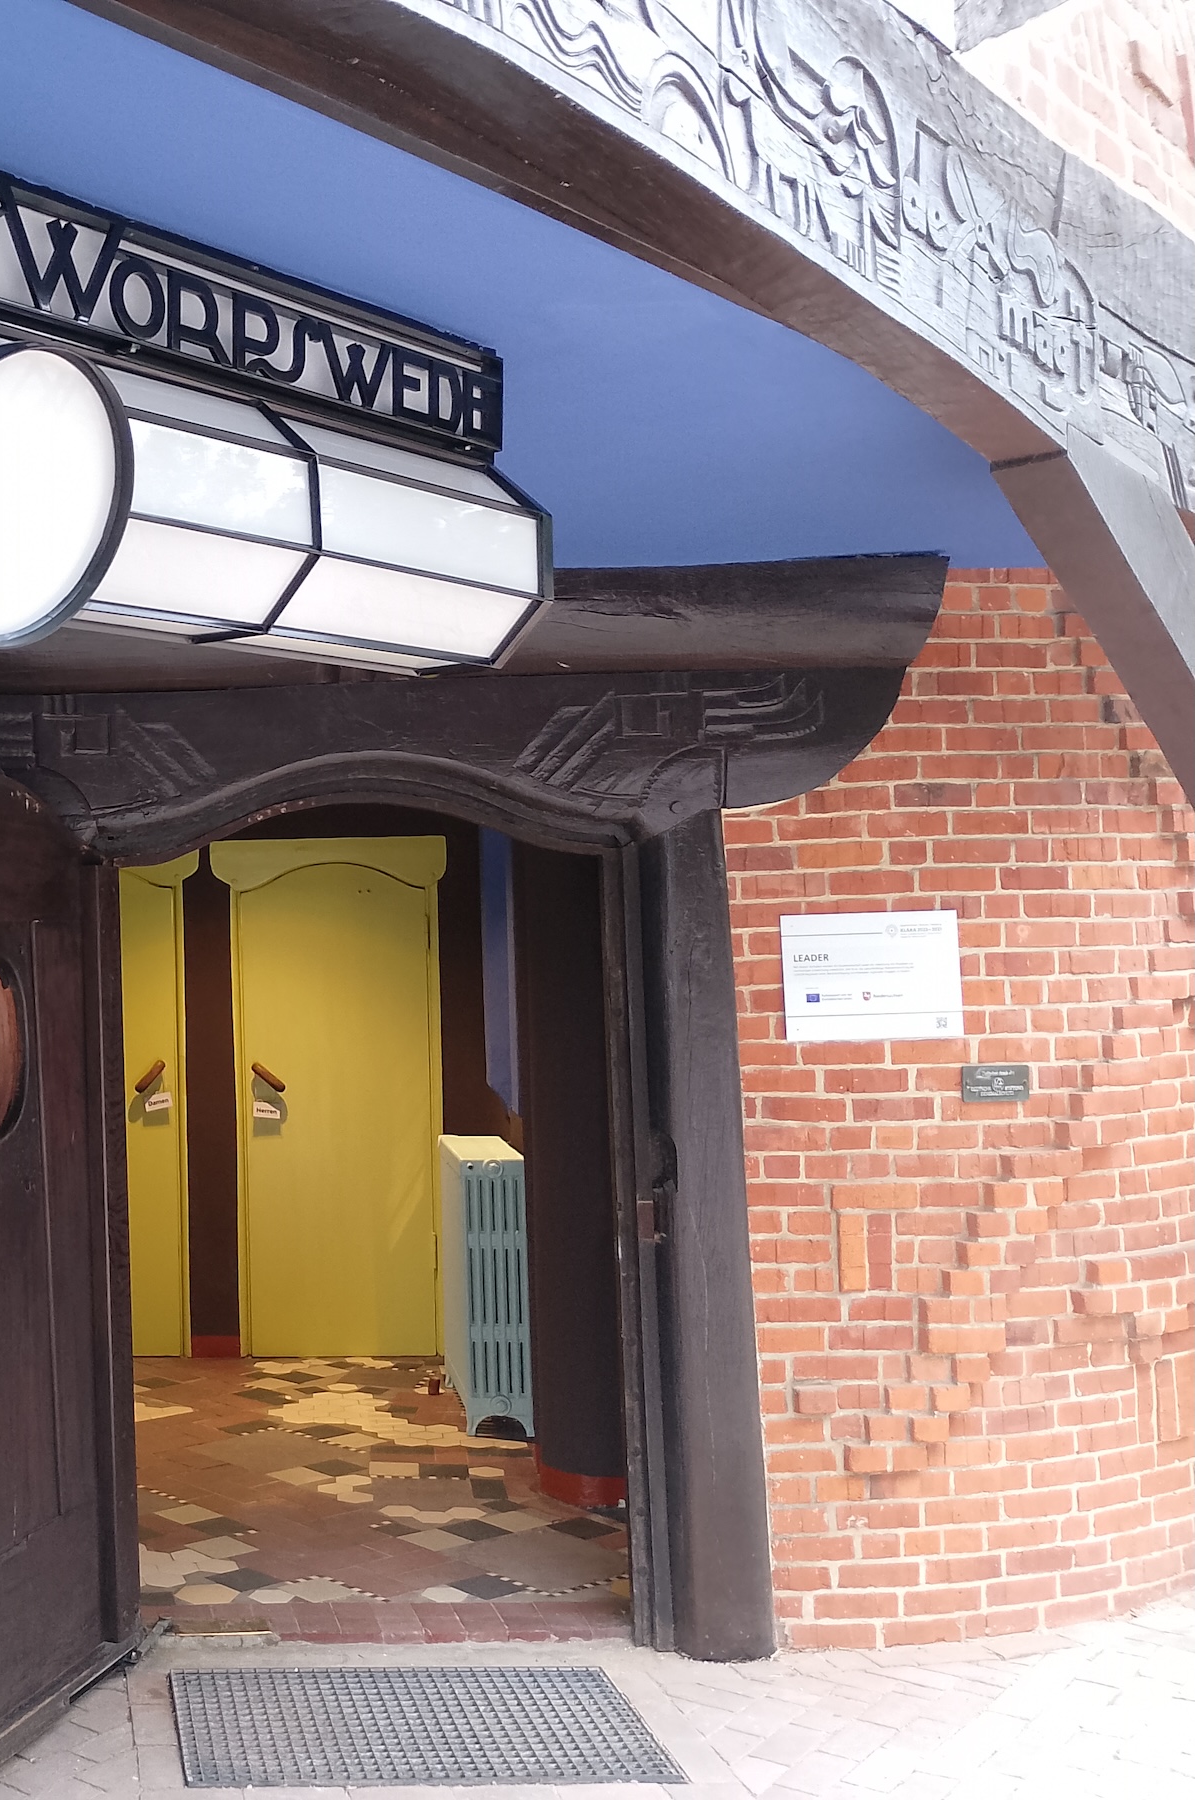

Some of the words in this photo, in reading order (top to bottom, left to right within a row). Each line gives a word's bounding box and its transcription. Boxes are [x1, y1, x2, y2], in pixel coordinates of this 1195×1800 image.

[793, 953, 829, 963] LEADER
[147, 1097, 170, 1107] Damen
[256, 1106, 278, 1115] Herren
